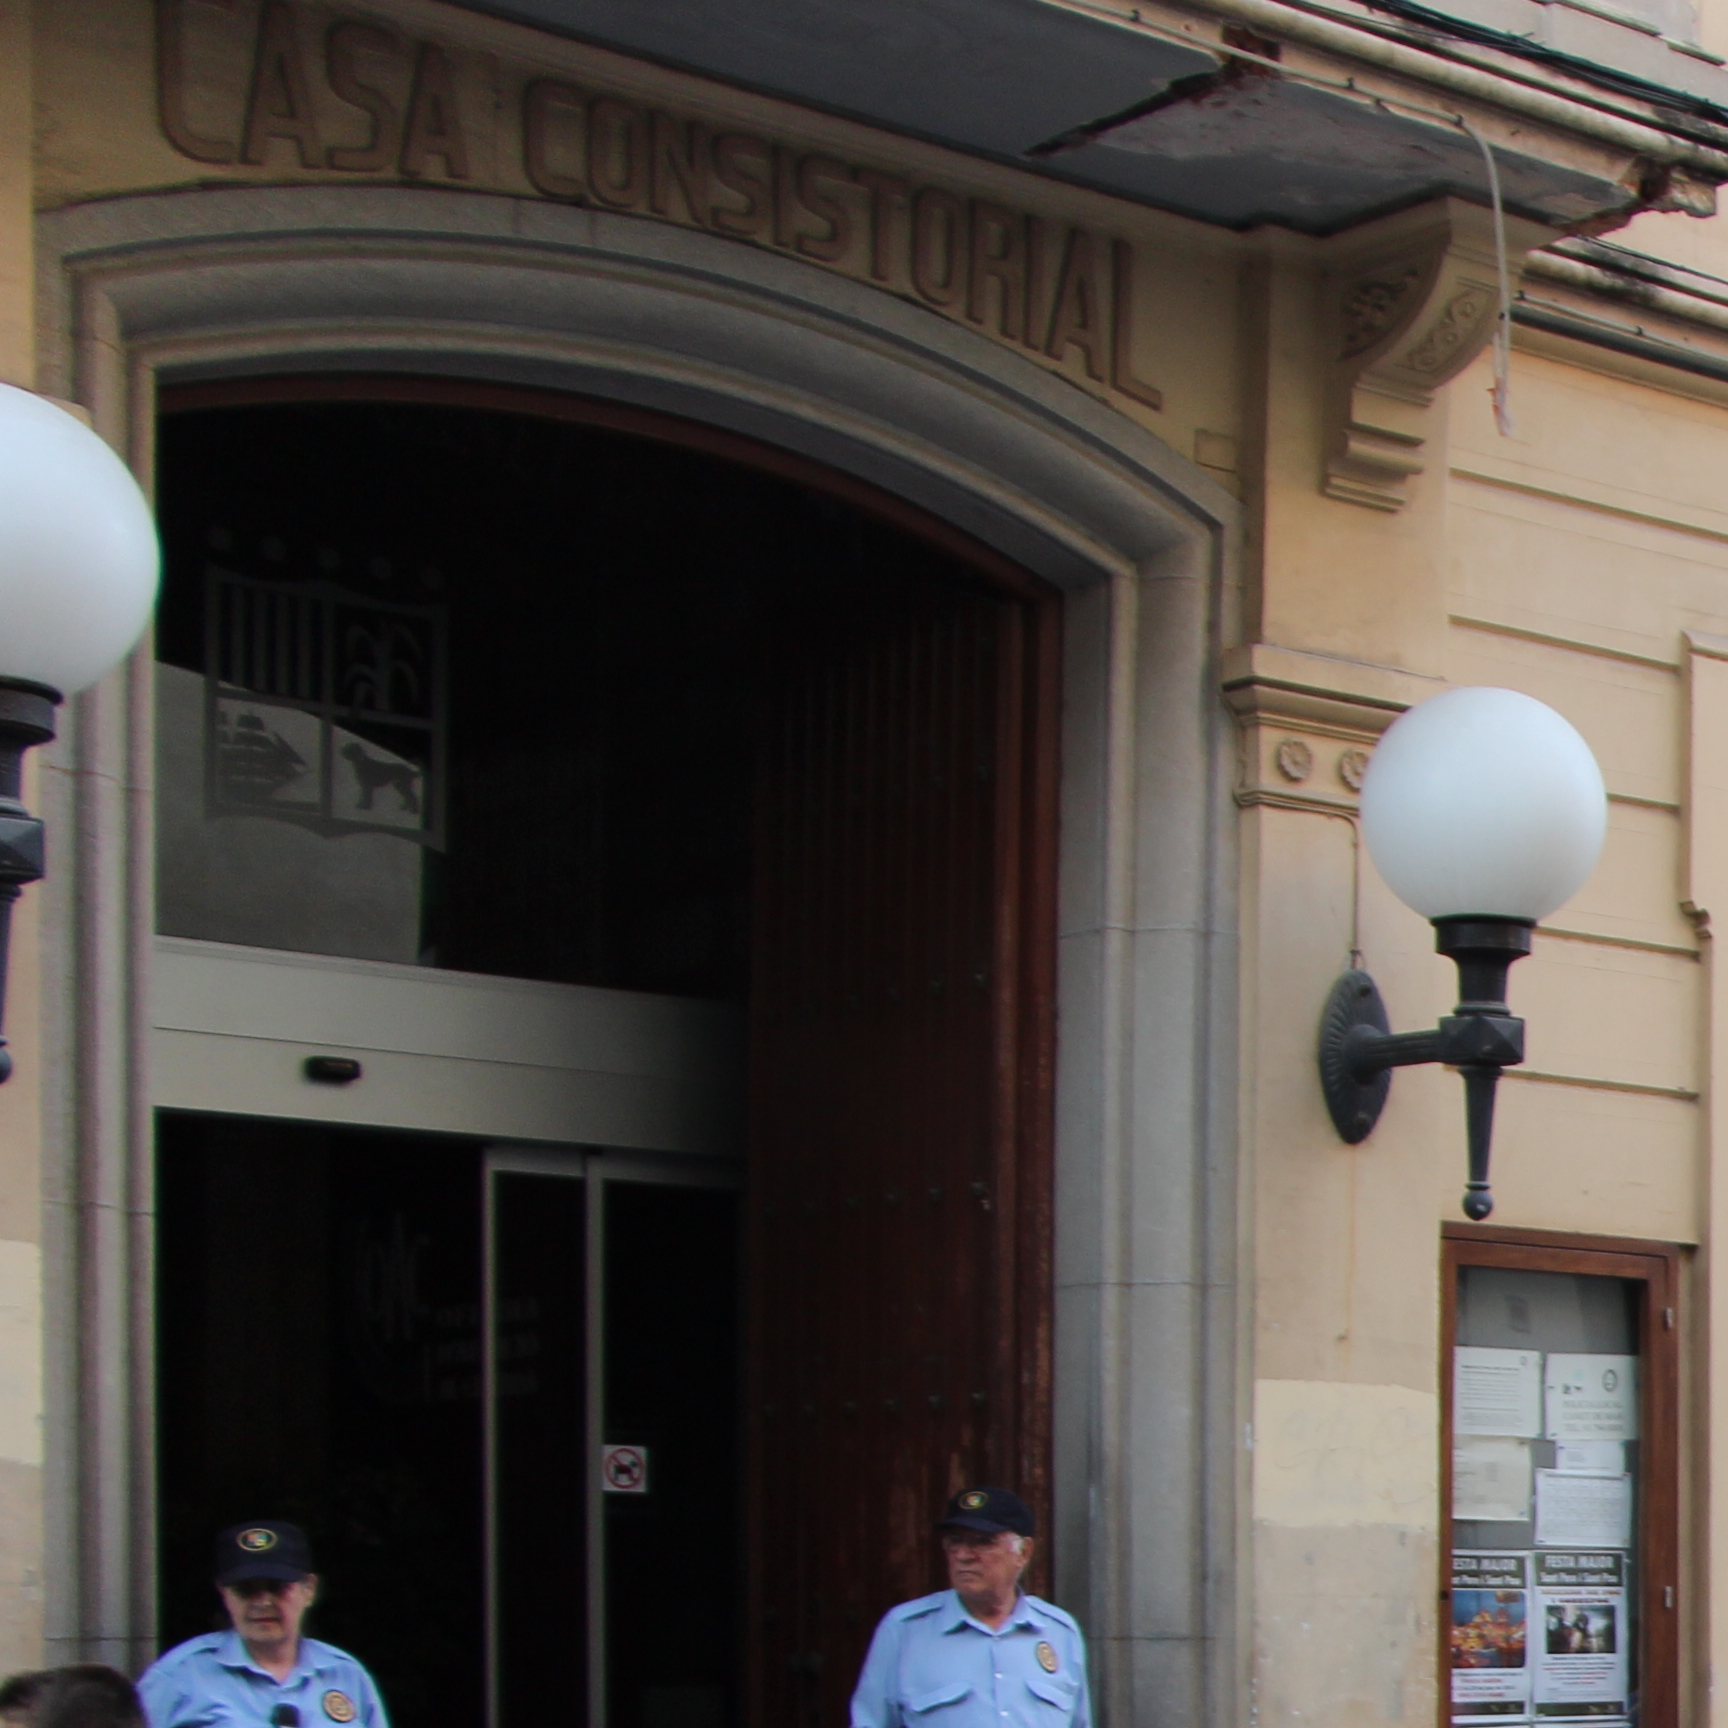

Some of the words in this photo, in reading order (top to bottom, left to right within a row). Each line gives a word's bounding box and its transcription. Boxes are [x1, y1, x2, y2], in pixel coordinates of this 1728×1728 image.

[154, 0, 472, 183] CASA
[521, 76, 1163, 409] CONSISTORIAL
[1452, 1557, 1477, 1571] ESTA
